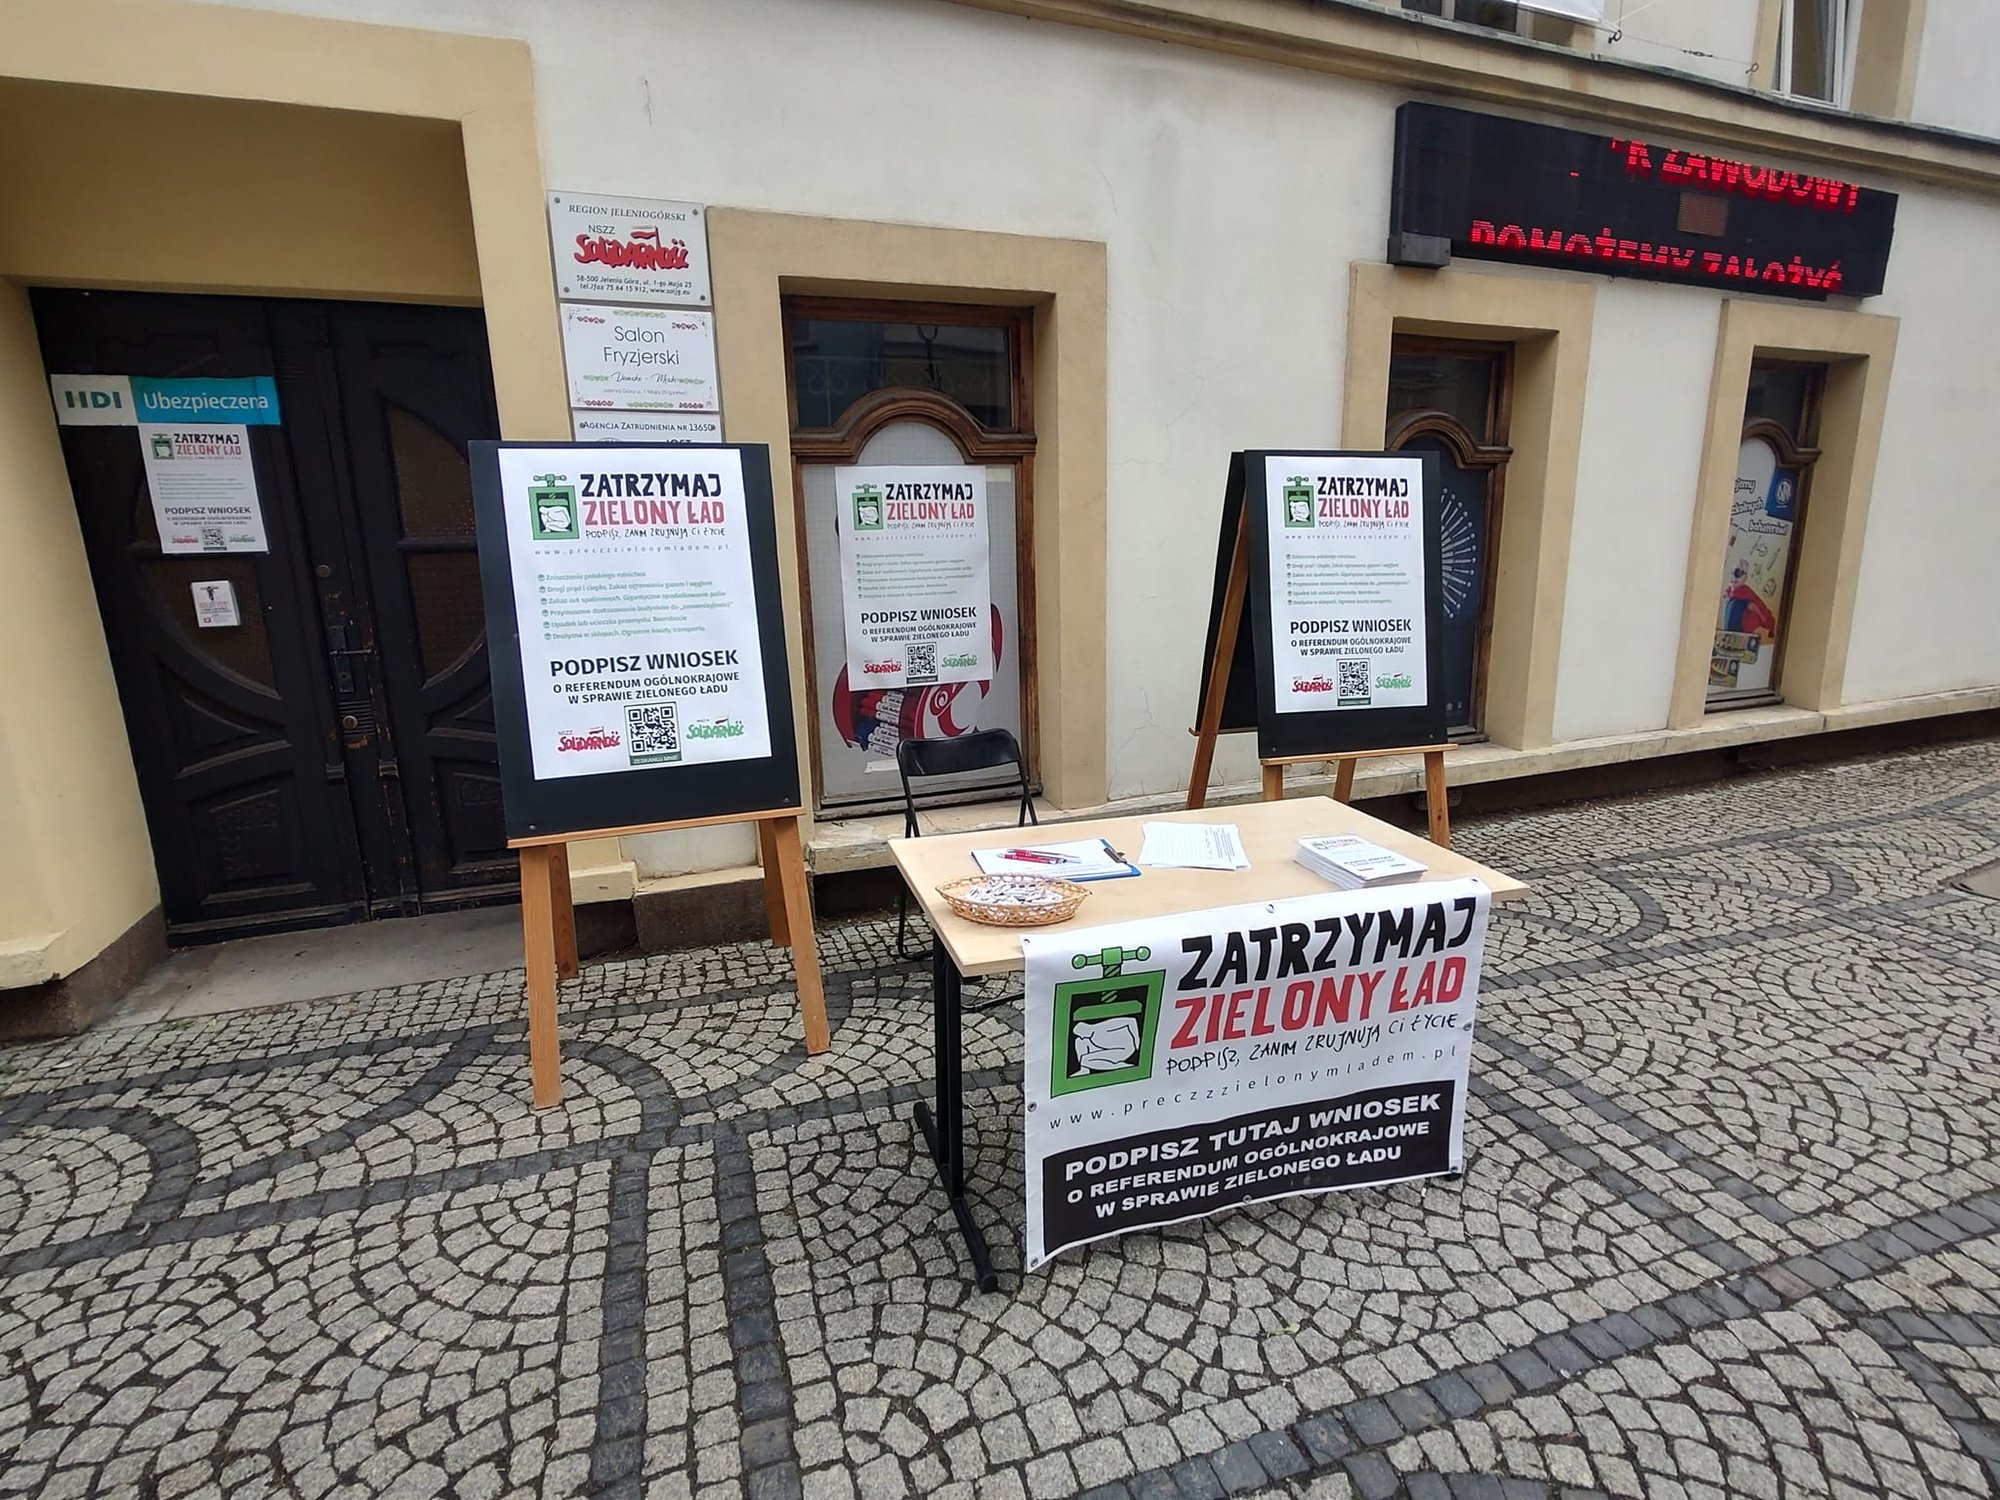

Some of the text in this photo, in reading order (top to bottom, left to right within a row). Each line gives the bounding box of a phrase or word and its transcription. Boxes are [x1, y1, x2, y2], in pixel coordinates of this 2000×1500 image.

[569, 204, 686, 221] REGION JELENIOGÓRSKI
[588, 225, 616, 235] NSZZ
[576, 275, 599, 283] 58-500
[600, 276, 622, 284] Jelenia
[668, 280, 683, 288] Maja
[614, 326, 665, 344] Salon
[603, 346, 680, 367] Fryzjerski
[689, 423, 712, 432] 13650
[174, 433, 240, 445] ZATRZYMAJ
[176, 444, 221, 456] ZIELONY
[580, 473, 722, 498] ZATRZYMAJ
[885, 483, 974, 501] ZATRZYMAJ
[1317, 476, 1409, 498] ZATRZYMAJ
[165, 506, 252, 515] PODPISZ WNIOSEK
[582, 500, 726, 526] ZIELONY ŁAD
[887, 502, 975, 521] ZIELONY ŁAD
[1318, 498, 1410, 519] ZIELONY ŁAD
[861, 607, 977, 624] PODPISZ WNIOSEK
[869, 626, 917, 635] REFERENDUM
[917, 622, 977, 632] OGÓLNOKRAJOWE
[1290, 619, 1412, 634] PODPISZ WNIOSEK
[879, 634, 911, 643] SPRAWIE
[912, 631, 950, 641] ZIELONEGO
[951, 630, 970, 638] ŁADU
[1299, 638, 1348, 647] REFERENDUM
[1350, 635, 1412, 645] OGÓLNOKRAJOWE
[1300, 646, 1404, 656] W SPRAWIE ZIELONEGO ŁADU
[551, 649, 740, 677] PODPISZ WNIOSEK
[553, 671, 740, 693] O REFERENDUM OGÓLNOKRAJOWE
[568, 684, 729, 704] W SPRAWIE ZIELONEGO ŁADU
[1177, 896, 1477, 992] ZATRZYMAJ
[1170, 956, 1468, 1050] ZIELONY ŁAD
[1249, 1040, 1298, 1062] ZANIM
[1305, 1028, 1381, 1053] ZRUJNUJĄ
[1065, 1092, 1442, 1182] PODPISZ TUTAJ WNIOSEK
[1067, 1120, 1430, 1204] O REFERENDUM OGÓLNOKRAJOWE
[1095, 1144, 1402, 1219] W SPRAWIE ZIELONEGO ŁADU
